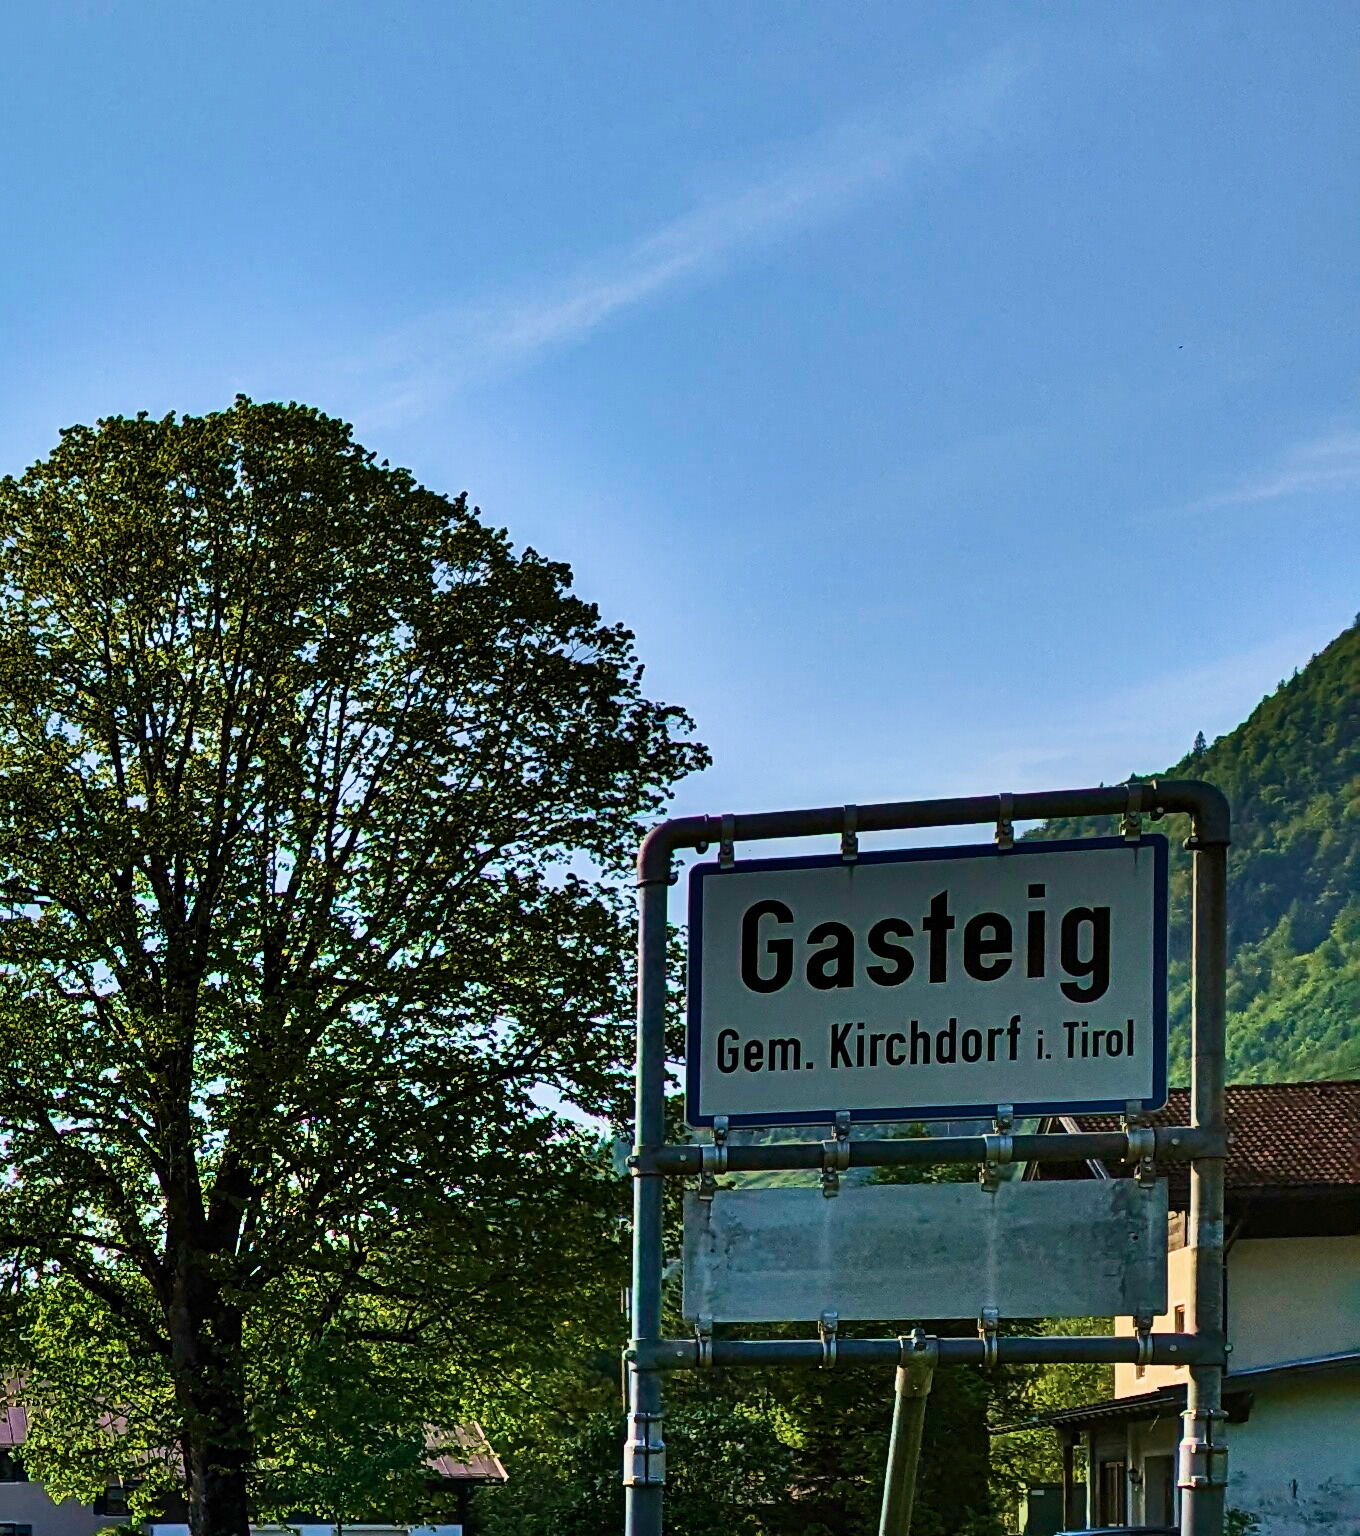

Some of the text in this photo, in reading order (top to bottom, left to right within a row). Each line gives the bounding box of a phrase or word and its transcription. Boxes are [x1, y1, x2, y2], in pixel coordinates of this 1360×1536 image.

[741, 883, 1111, 1003] Gasteig
[717, 1015, 1135, 1074] Gem. Kirchdorf i. Tirol
